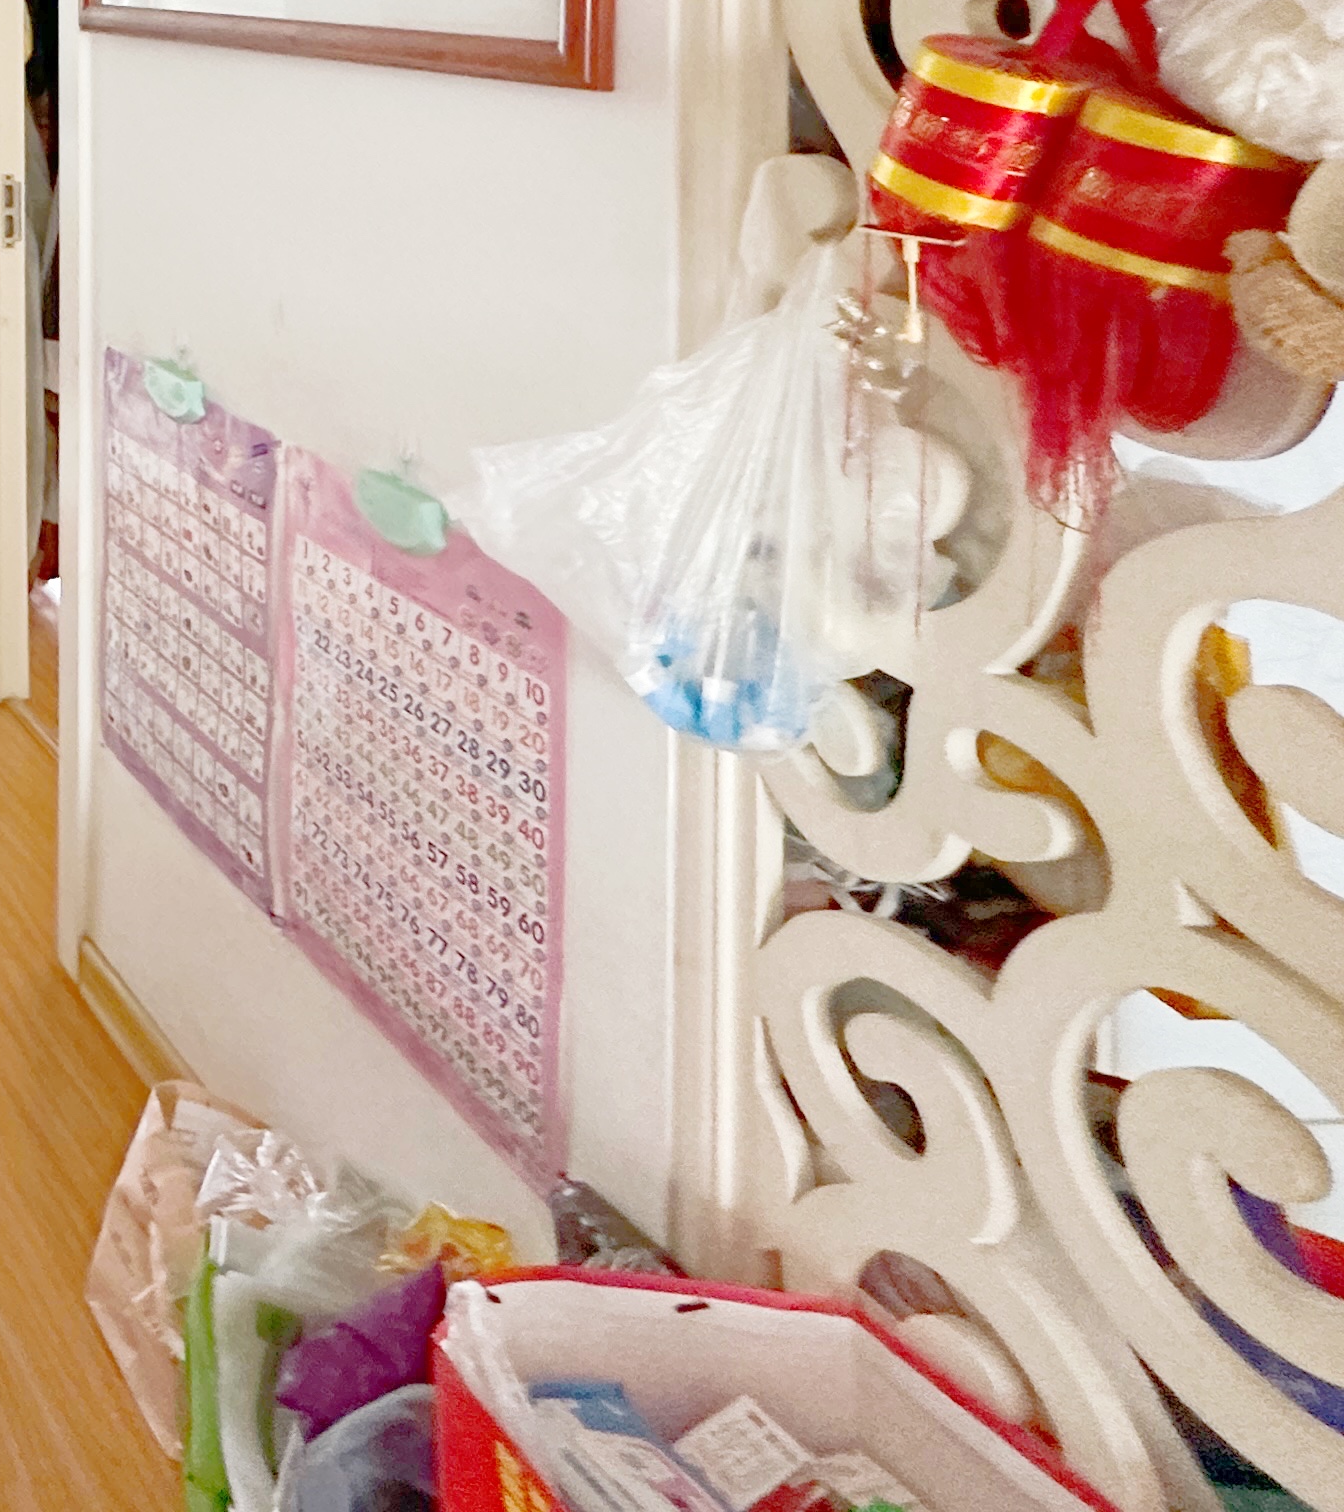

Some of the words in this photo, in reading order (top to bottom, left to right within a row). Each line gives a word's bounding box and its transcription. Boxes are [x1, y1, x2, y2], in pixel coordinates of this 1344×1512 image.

[304, 541, 307, 558] 1
[323, 554, 330, 573] 2
[343, 567, 351, 586] 3
[365, 583, 373, 600] 4
[389, 596, 399, 615] 5
[416, 613, 425, 631] 6
[443, 627, 452, 646] 7
[470, 644, 480, 665] 8
[498, 662, 508, 682] 9
[525, 677, 544, 705] 10
[314, 629, 330, 654] 22
[335, 644, 351, 669] 23
[356, 659, 373, 685] 24
[380, 676, 398, 702] 25
[404, 694, 424, 721] 26
[430, 712, 451, 737] 27
[457, 730, 479, 759] 28
[487, 750, 511, 779] 29
[518, 771, 546, 802] 30
[410, 651, 424, 676] 16
[437, 668, 452, 691] 17
[464, 687, 480, 713] 18
[492, 705, 509, 730] 19
[518, 724, 545, 754] 20
[314, 746, 330, 772] 52
[336, 763, 351, 789] 53
[358, 782, 374, 808] 54
[378, 801, 396, 829] 55
[402, 822, 421, 850] 56
[427, 842, 448, 869] 57
[456, 864, 479, 895] 58
[487, 887, 510, 917] 59
[518, 913, 544, 944] 60
[379, 717, 396, 744] 35
[403, 736, 422, 763] 36
[428, 755, 449, 782] 37
[456, 774, 478, 804] 38
[486, 795, 510, 824] 39
[518, 819, 545, 850] 40
[427, 800, 448, 825] 47
[455, 821, 478, 850] 48
[487, 843, 511, 870] 49
[519, 864, 545, 897] 50
[313, 822, 328, 850] 72
[333, 840, 348, 870] 73
[354, 861, 370, 889] 74
[376, 881, 394, 911] 75
[400, 903, 420, 934] 76
[427, 927, 447, 955] 77
[456, 950, 478, 984] 78
[486, 975, 508, 1008] 79
[516, 1004, 539, 1038] 80
[400, 865, 420, 892] 66
[427, 887, 449, 912] 67
[456, 911, 478, 939] 68
[487, 935, 510, 962] 69
[519, 958, 542, 990] 70
[426, 971, 446, 998] 87
[454, 996, 476, 1029] 88
[483, 1022, 506, 1053] 89
[513, 1050, 539, 1085] 90
[482, 1068, 506, 1100] 99
